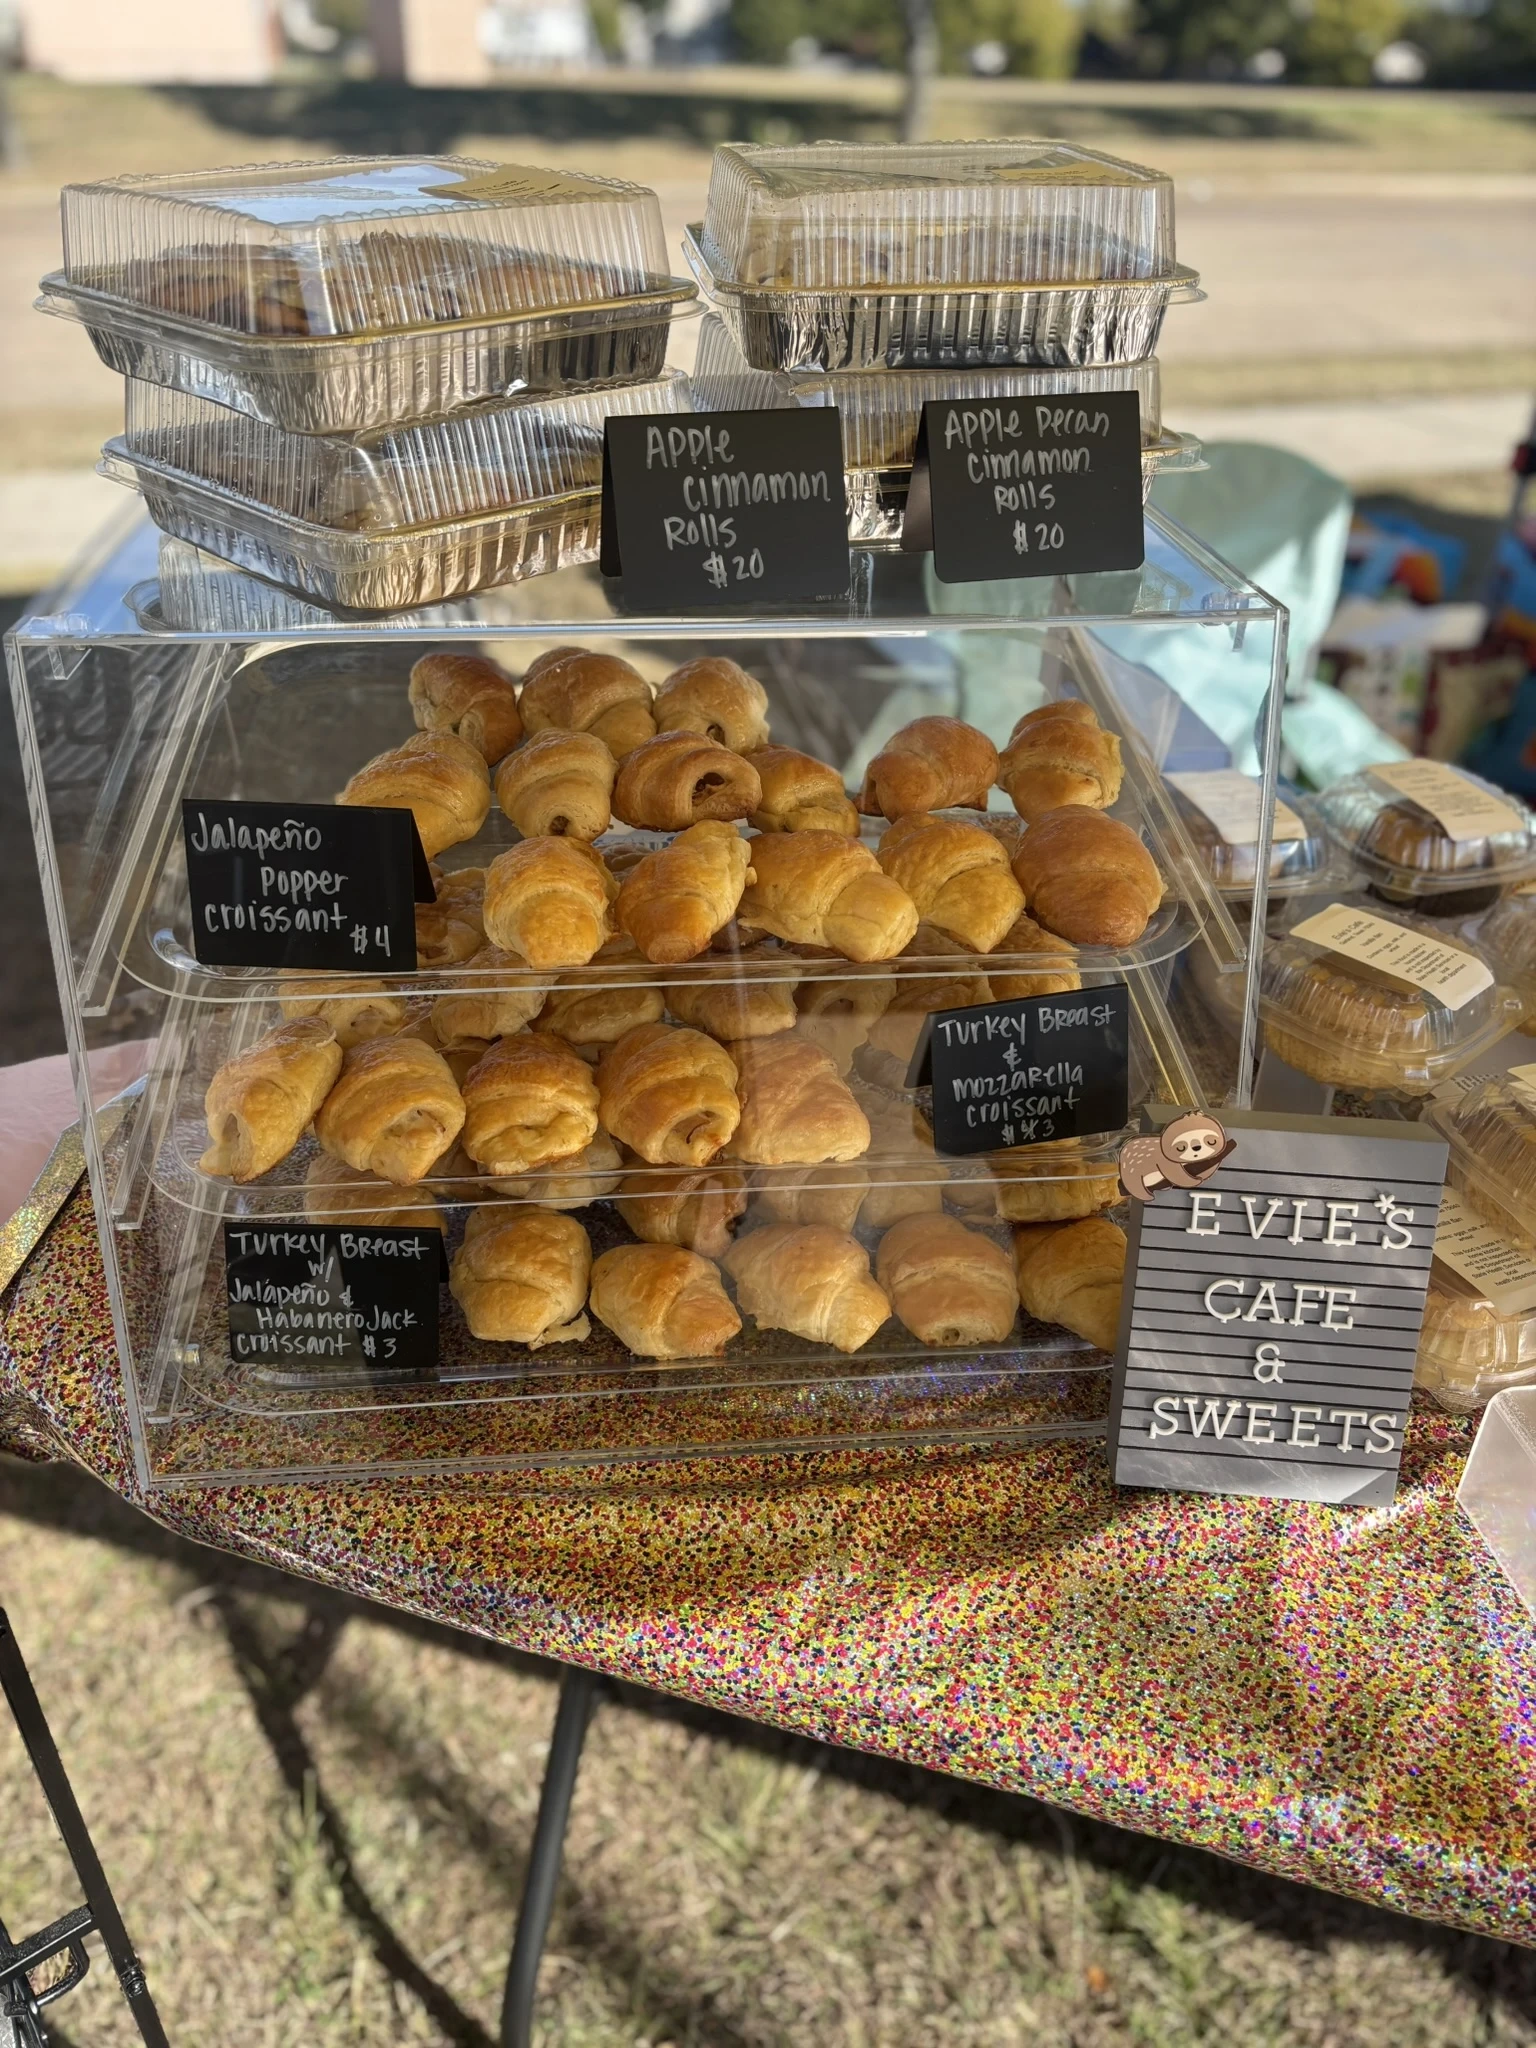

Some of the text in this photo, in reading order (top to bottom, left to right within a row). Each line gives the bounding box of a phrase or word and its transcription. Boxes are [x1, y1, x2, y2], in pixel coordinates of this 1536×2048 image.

[1035, 406, 1109, 437] Pecan
[994, 481, 1055, 514] Rolls
[664, 513, 737, 550] Rolls
[191, 812, 321, 860] Jalapeño
[205, 901, 347, 933] croissant
[938, 1013, 1026, 1046] Turkey
[1002, 1042, 1021, 1071] &
[966, 1086, 1080, 1127] croissant
[229, 1232, 325, 1265] Turkey
[229, 1277, 330, 1309] Jalapeño
[1204, 1278, 1357, 1332] CAFE
[256, 1305, 418, 1331] Habanero Jack
[237, 1331, 351, 1356] croissant
[1252, 1341, 1286, 1384] &
[1149, 1395, 1397, 1454] SWEETS
